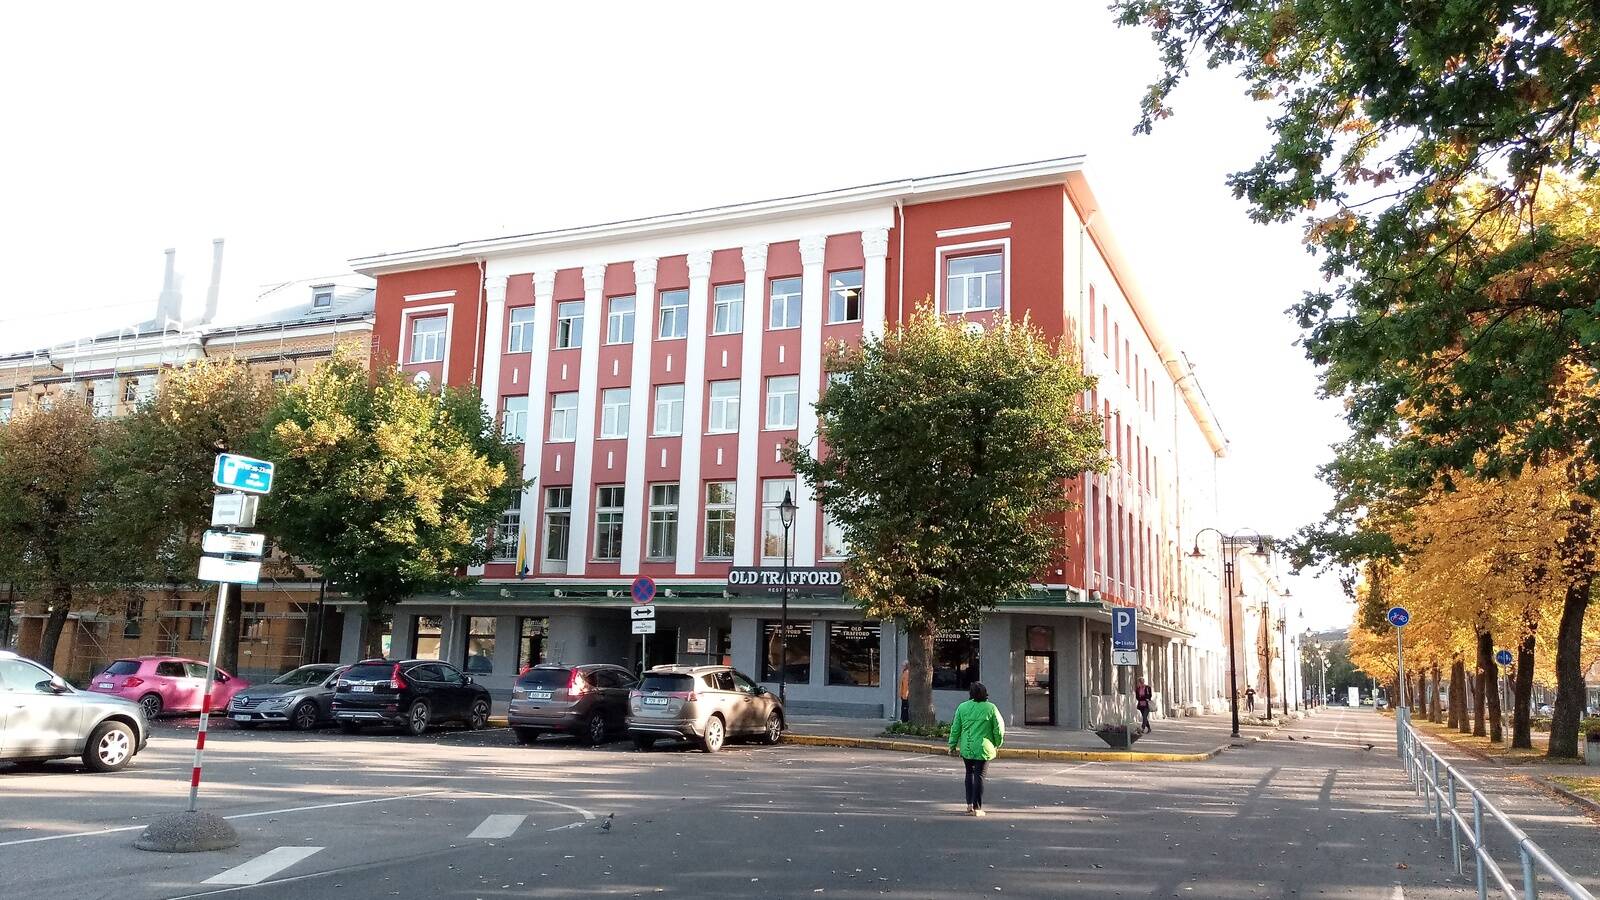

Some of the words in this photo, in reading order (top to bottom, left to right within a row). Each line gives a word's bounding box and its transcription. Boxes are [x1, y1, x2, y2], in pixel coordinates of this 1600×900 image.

[728, 570, 759, 585] OLD
[760, 571, 842, 585] TRAFFORD
[1117, 611, 1131, 634] P
